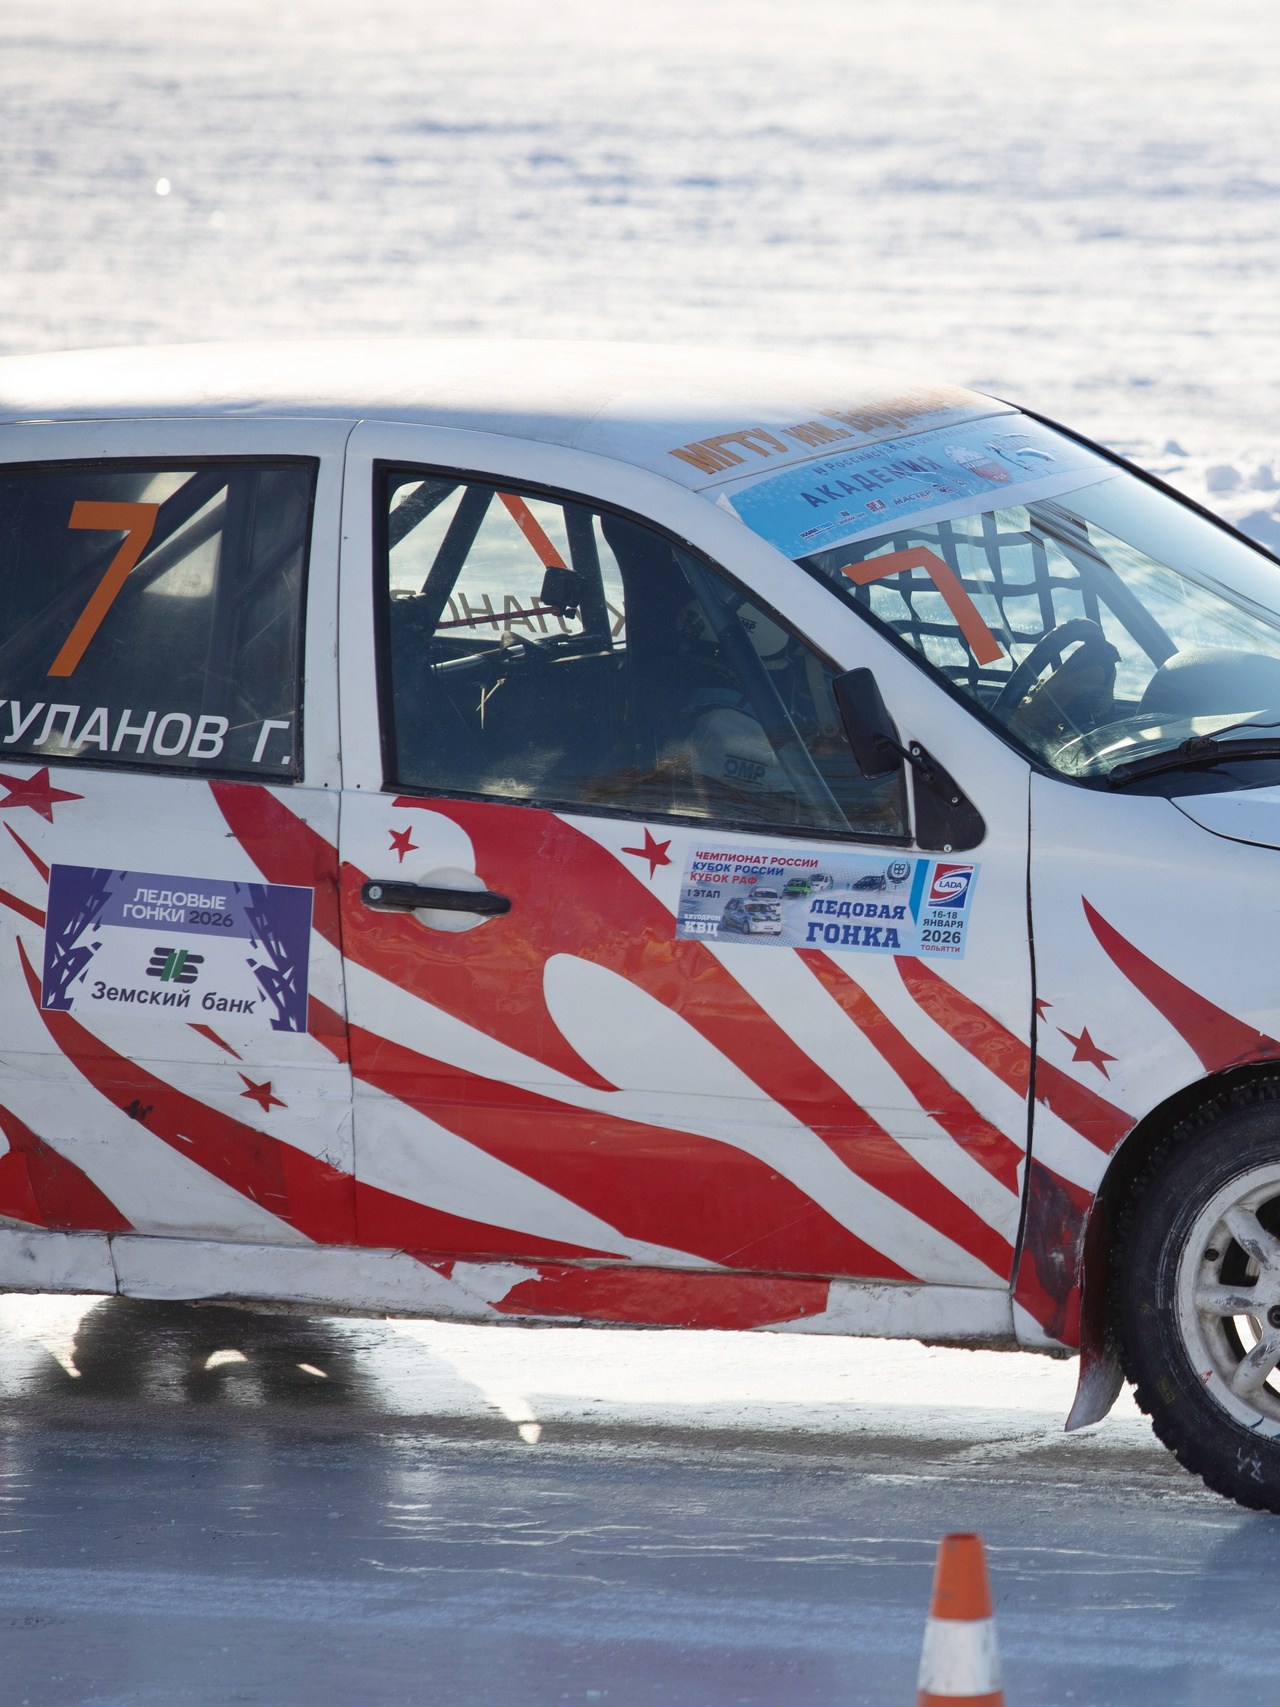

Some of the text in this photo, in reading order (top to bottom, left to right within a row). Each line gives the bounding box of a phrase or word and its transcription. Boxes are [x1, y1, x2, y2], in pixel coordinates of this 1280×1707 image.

[667, 427, 789, 475] МГТУ
[800, 455, 944, 507] АКАДЕМИЯ
[47, 501, 160, 677] 7
[840, 545, 1004, 666] 7
[0, 700, 291, 765] УЛАНОВ Г.
[724, 758, 766, 782] OMP
[692, 861, 785, 876] КУБОК РОССИИ
[695, 851, 819, 868] ЧЕМПИОНАТ РОССИИ
[690, 872, 758, 885] КУБОК РАФ
[938, 880, 962, 890] LADA
[133, 888, 227, 911] ЛЕДОВЫЕ
[693, 889, 721, 898] ЭТАП
[122, 903, 234, 928] ГОНКИ 2026
[809, 899, 907, 920] ЛЕДОВАЯ
[931, 910, 958, 919] 16-18
[683, 920, 719, 937] КВЦ
[923, 918, 964, 929] ЯНВАРЯ
[805, 921, 901, 949] ГОНКА
[920, 929, 961, 944] 2026
[920, 944, 960, 953] ТОЛЬЯТТИ
[91, 981, 257, 1015] Земский банк
